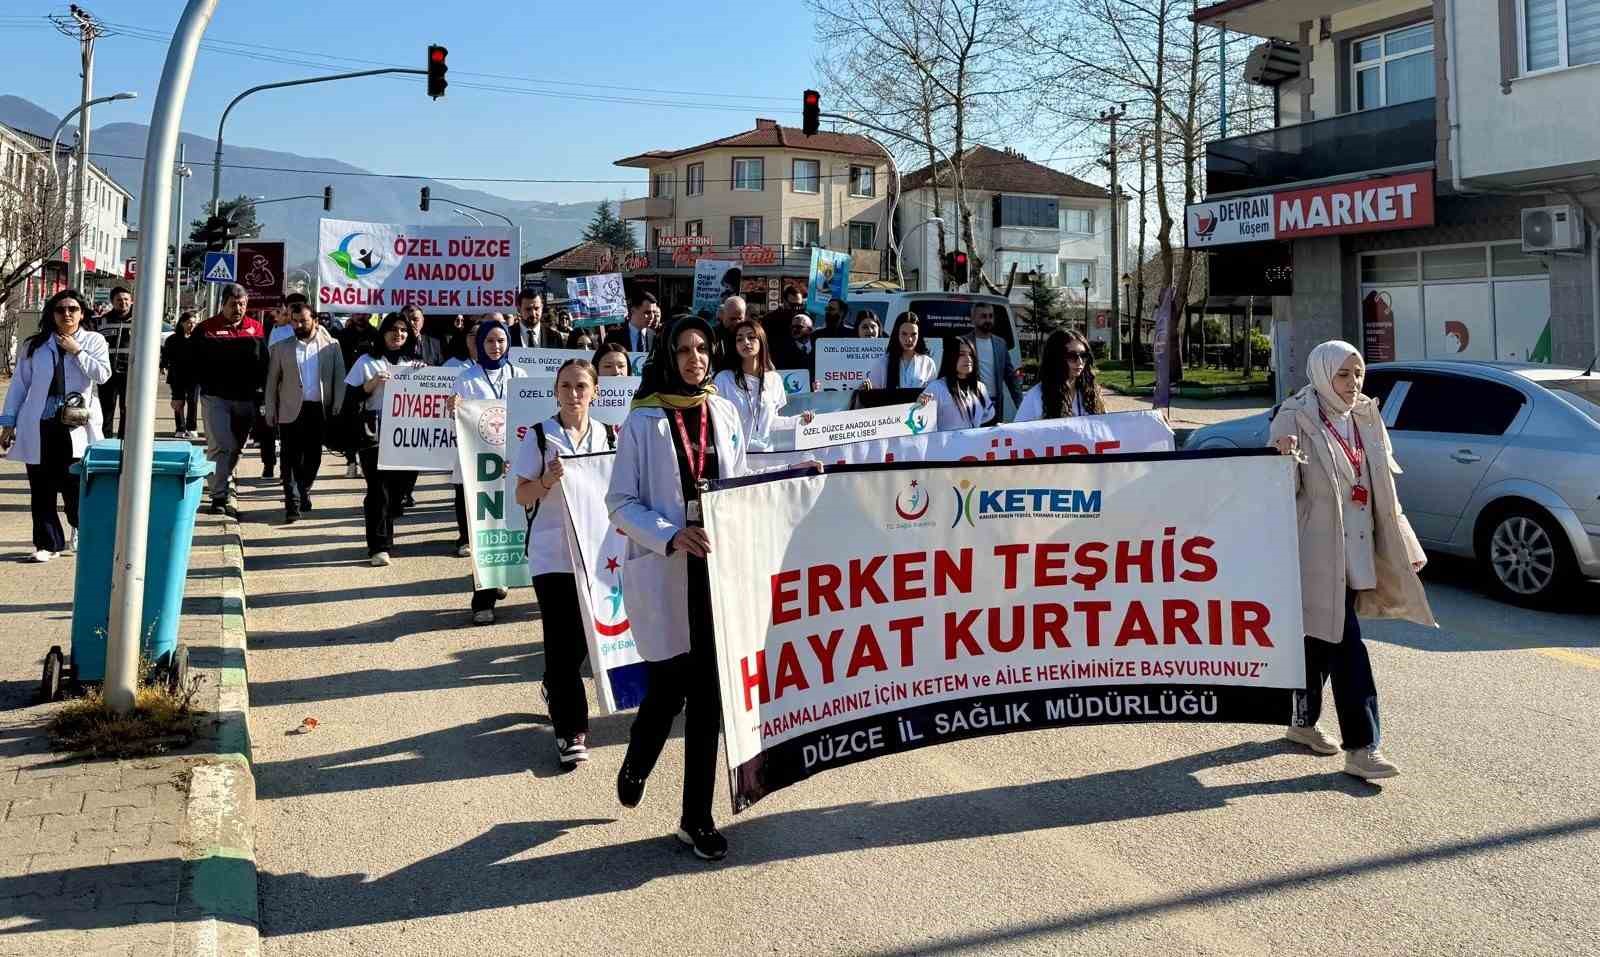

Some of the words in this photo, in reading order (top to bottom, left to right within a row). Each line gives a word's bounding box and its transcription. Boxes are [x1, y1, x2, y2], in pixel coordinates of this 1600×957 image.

[1219, 198, 1269, 223] DEVRAN
[1279, 183, 1417, 232] MARKET
[1239, 221, 1269, 238] Köşem
[393, 234, 442, 257] ÖZEL
[448, 235, 511, 257] DÜZCE
[404, 263, 495, 281] ANADOLU
[320, 283, 385, 305] SAĞLIK
[391, 288, 461, 306] MESLEK
[466, 285, 520, 307] LİSESİ
[824, 371, 863, 381] SENDE
[392, 387, 449, 419] DİYABET
[978, 489, 1102, 514] KETEM
[770, 548, 973, 626] ERKEN
[994, 526, 1218, 591] TEŞHİS
[740, 616, 924, 712] HAYAT
[944, 599, 1274, 661] KURTARIR
[874, 681, 908, 705] İÇİN
[912, 673, 969, 697] KETEM
[972, 675, 991, 687] ve
[995, 662, 1033, 685] AİLE
[1037, 658, 1136, 681] HEKİMİNİZE
[802, 726, 885, 768] DÜZCE
[898, 716, 924, 743] İL
[934, 702, 1032, 735] SAĞLIK
[1045, 689, 1218, 720] MÜDÜRLÜĞÜ
